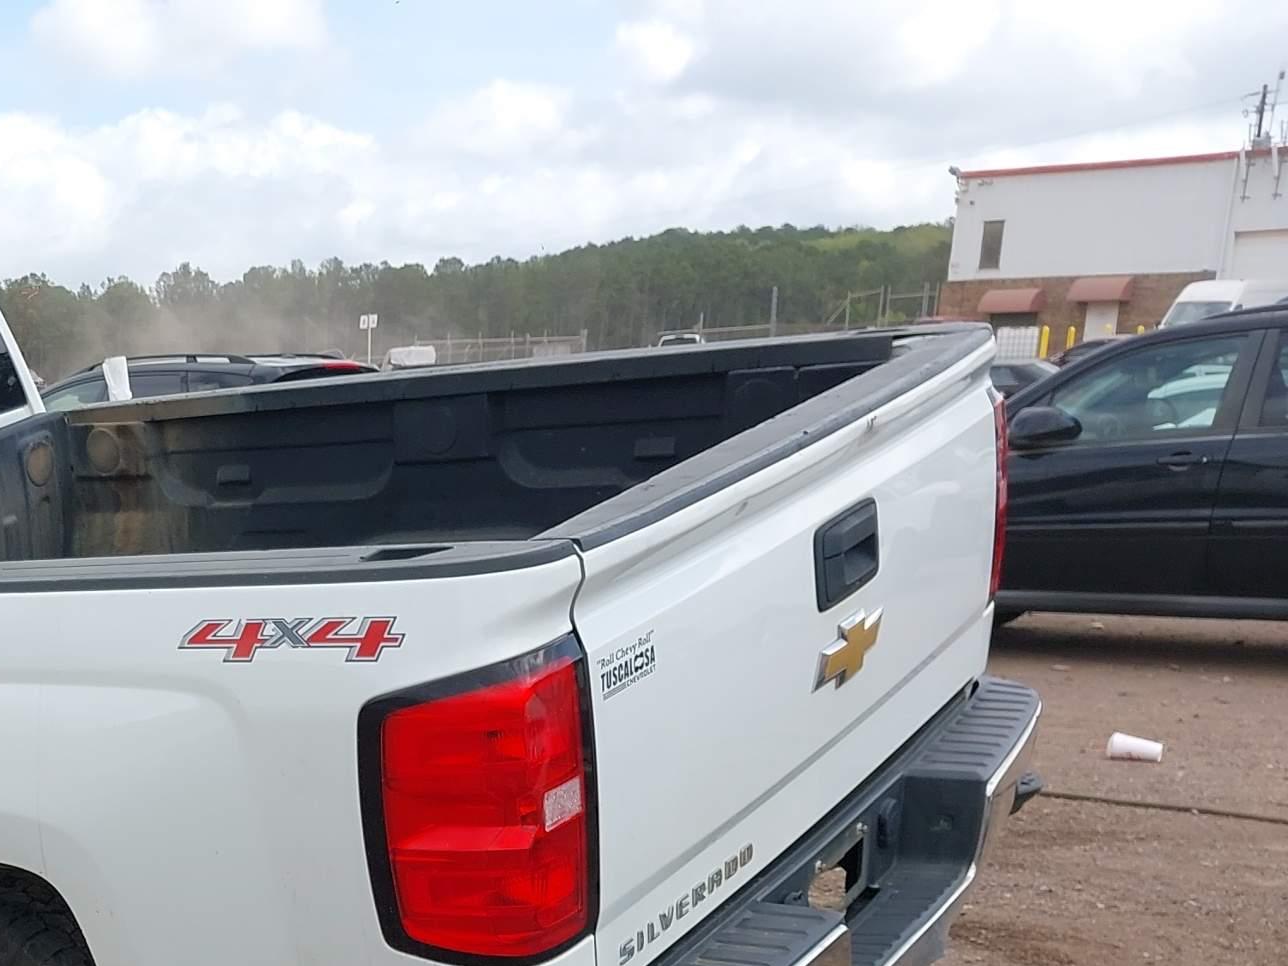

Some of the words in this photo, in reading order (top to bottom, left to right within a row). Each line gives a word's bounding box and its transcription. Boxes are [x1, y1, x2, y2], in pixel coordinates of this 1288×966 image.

[615, 643, 638, 661] Chevy
[626, 664, 656, 687] CHEVROLET
[619, 843, 753, 966] SILVERADO
